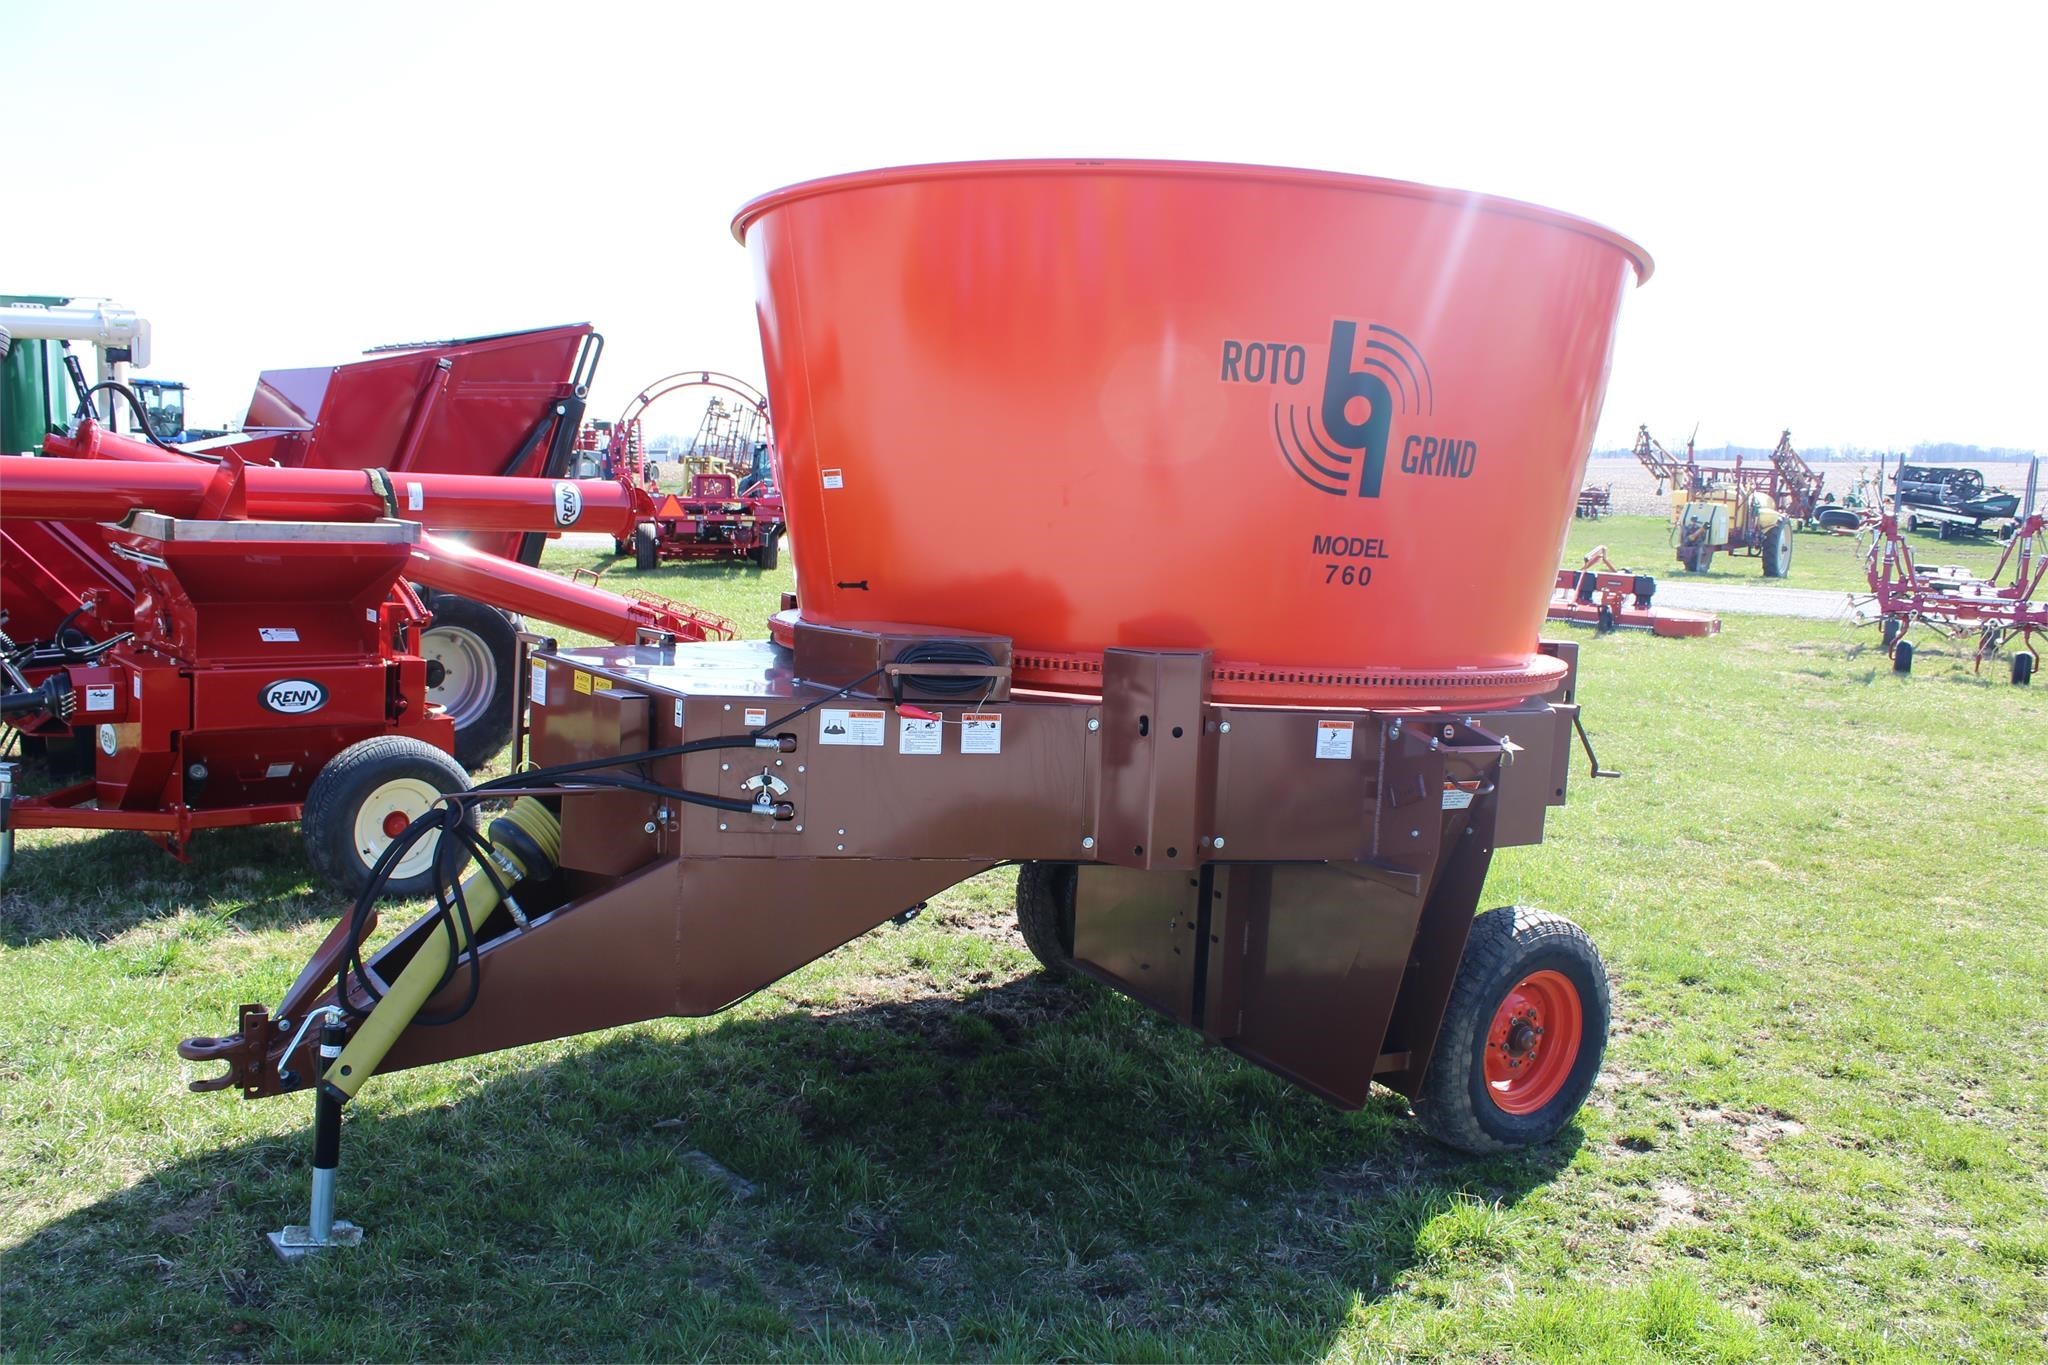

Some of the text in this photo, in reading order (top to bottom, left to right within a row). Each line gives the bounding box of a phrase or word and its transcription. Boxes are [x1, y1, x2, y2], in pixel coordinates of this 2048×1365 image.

[1221, 340, 1306, 385] ROTO
[1401, 434, 1478, 479] GRIND
[562, 486, 577, 522] RENN
[1312, 534, 1389, 559] MODEL
[1325, 564, 1372, 586] 760
[270, 690, 319, 706] RENN
